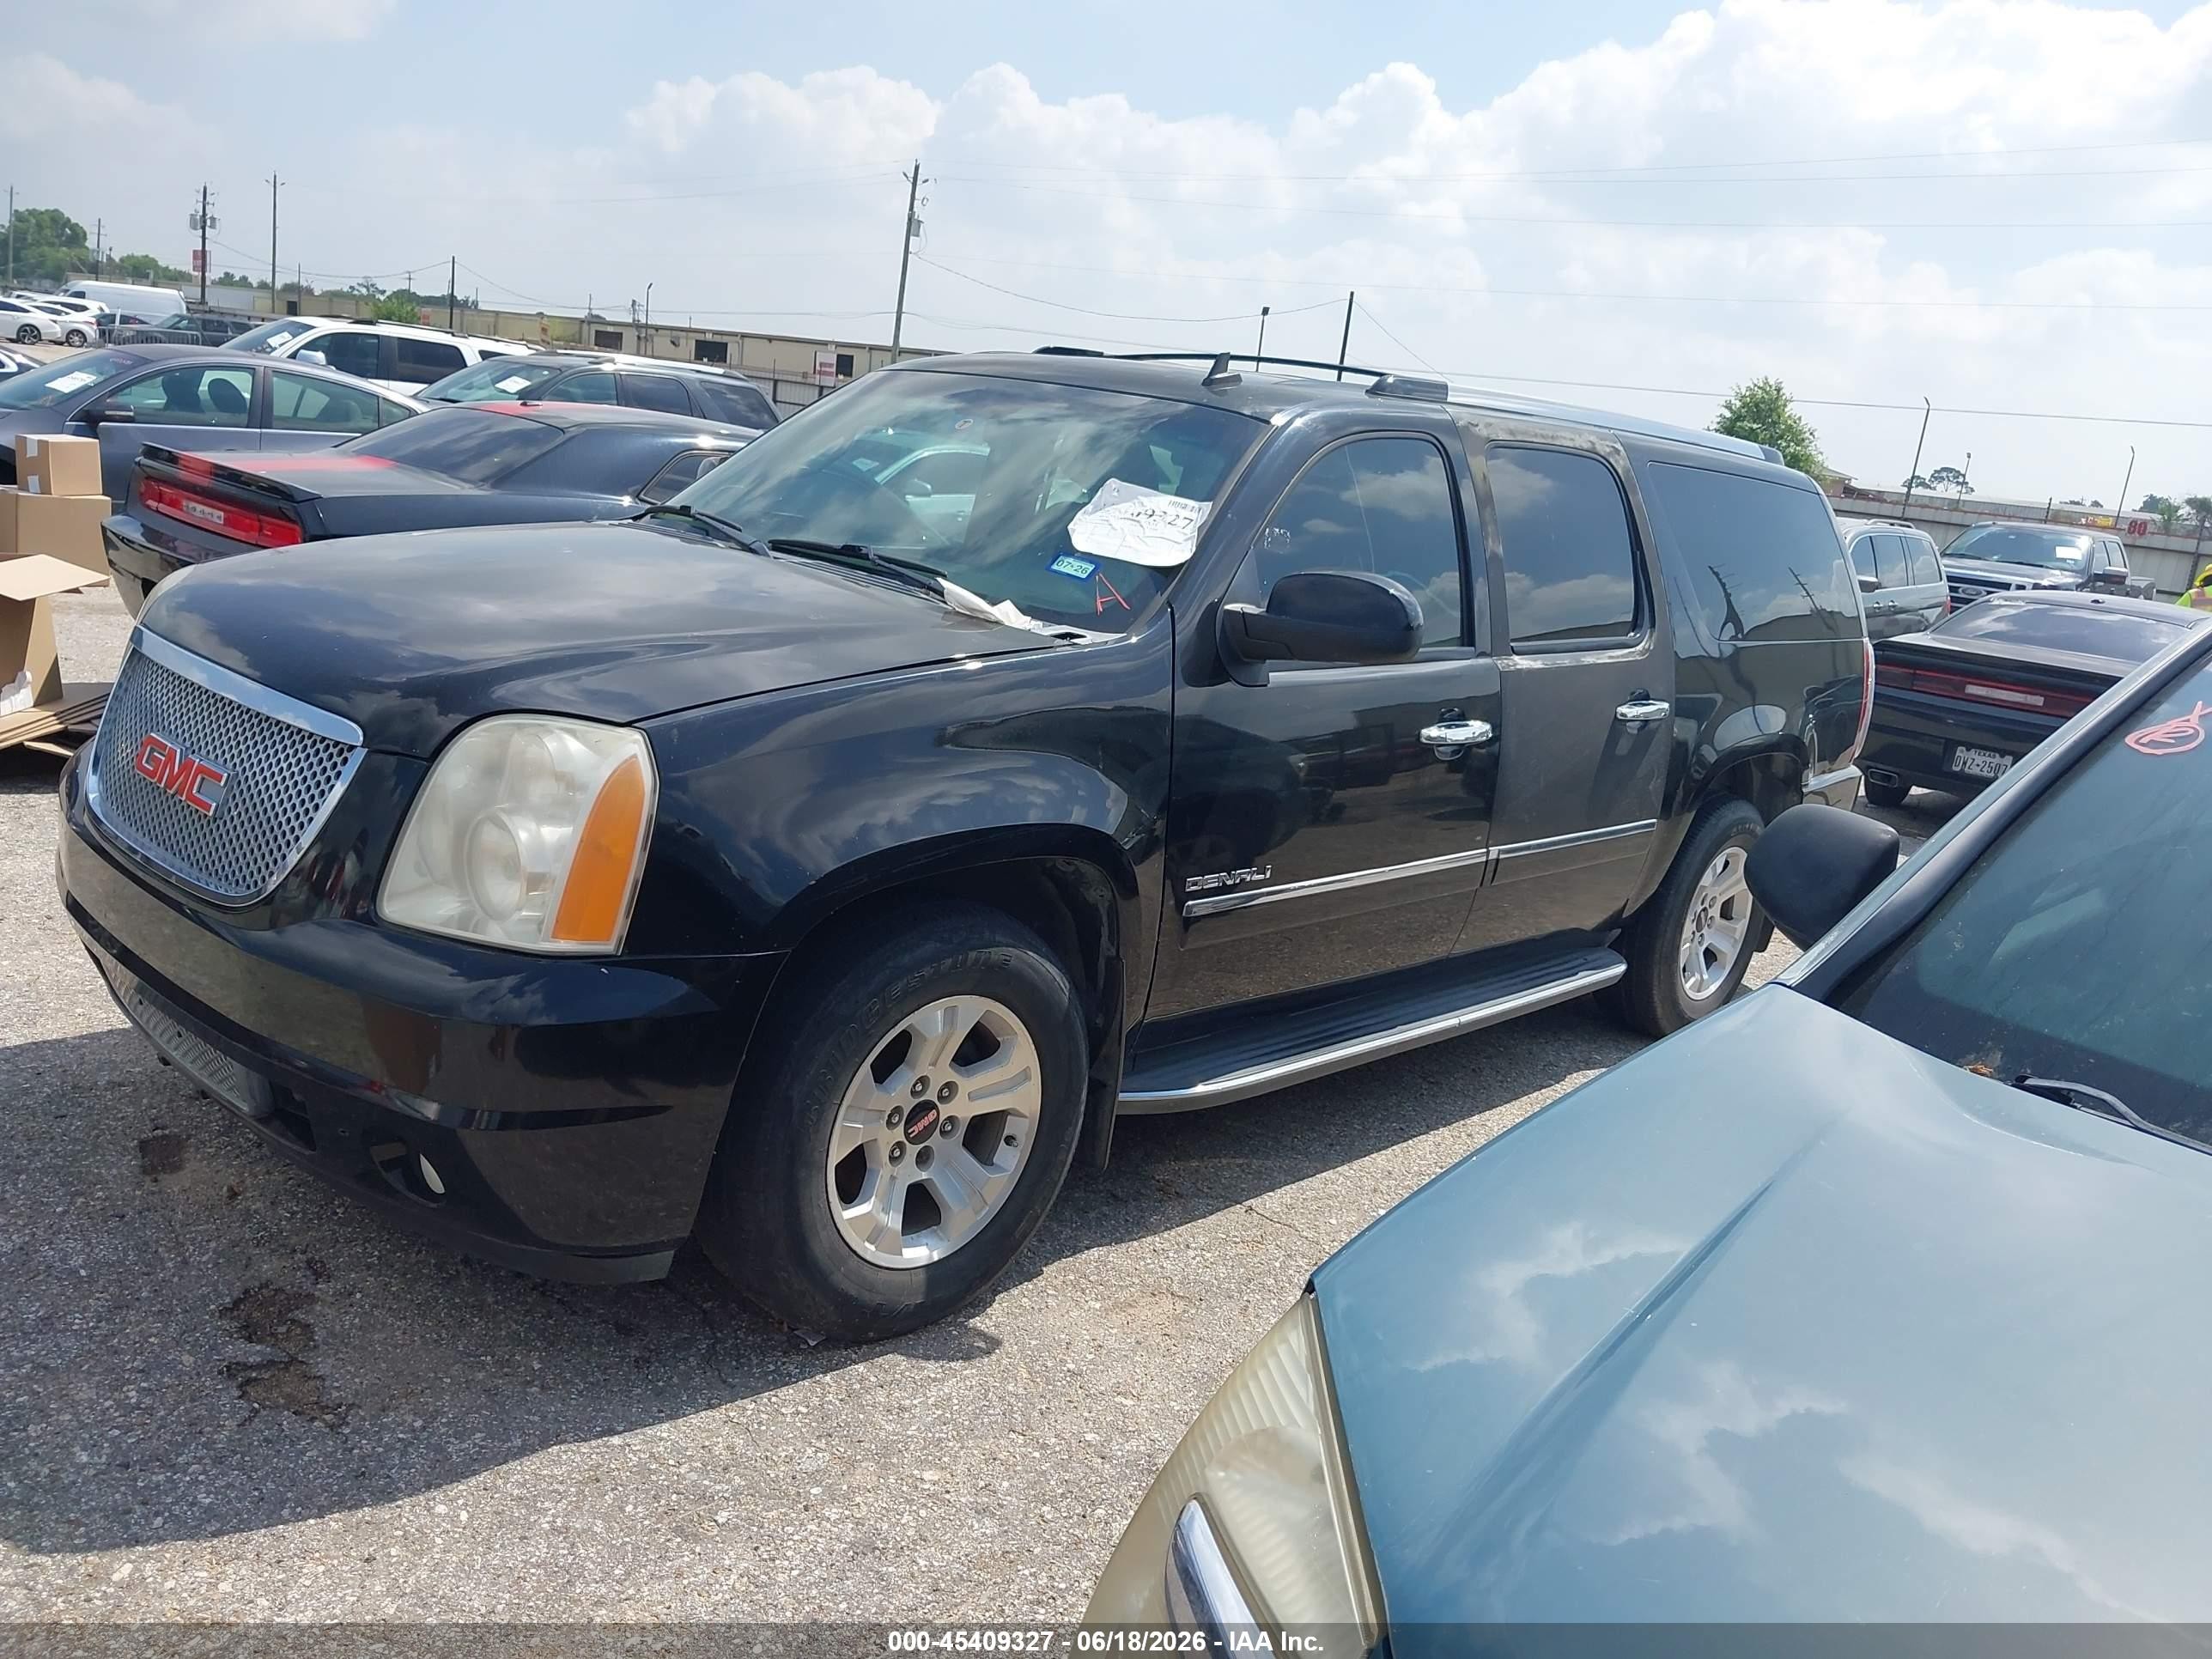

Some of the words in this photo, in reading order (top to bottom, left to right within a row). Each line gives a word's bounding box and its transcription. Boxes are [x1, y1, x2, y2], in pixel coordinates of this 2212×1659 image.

[2127, 518, 2149, 537] 80
[1095, 572, 1132, 617] A
[1972, 749, 1997, 760] TEXAS
[133, 732, 230, 817] GMC
[1184, 865, 1273, 893] DENALI
[907, 1109, 938, 1139] GMC
